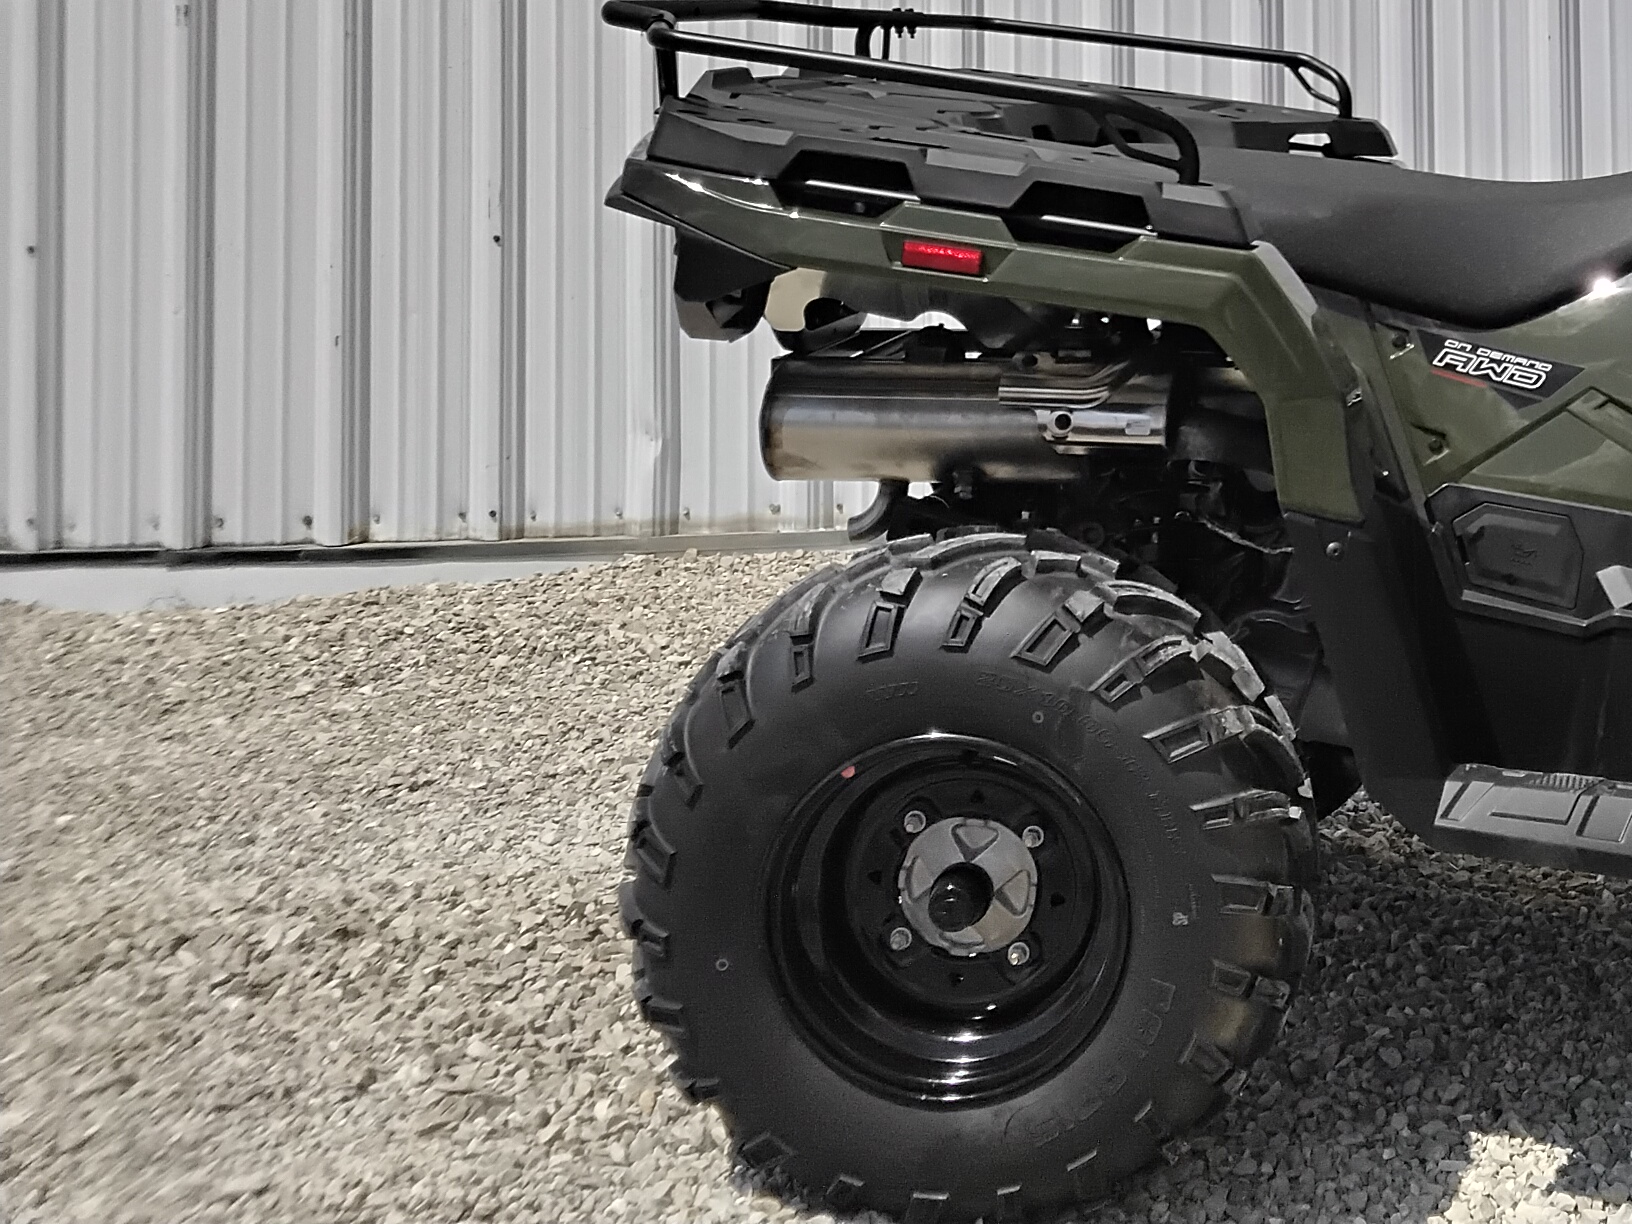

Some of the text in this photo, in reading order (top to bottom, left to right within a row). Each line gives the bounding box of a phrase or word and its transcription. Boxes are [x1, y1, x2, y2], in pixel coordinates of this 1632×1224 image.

[1432, 348, 1550, 389] AWD
[1444, 339, 1553, 372] ON DEMAND
